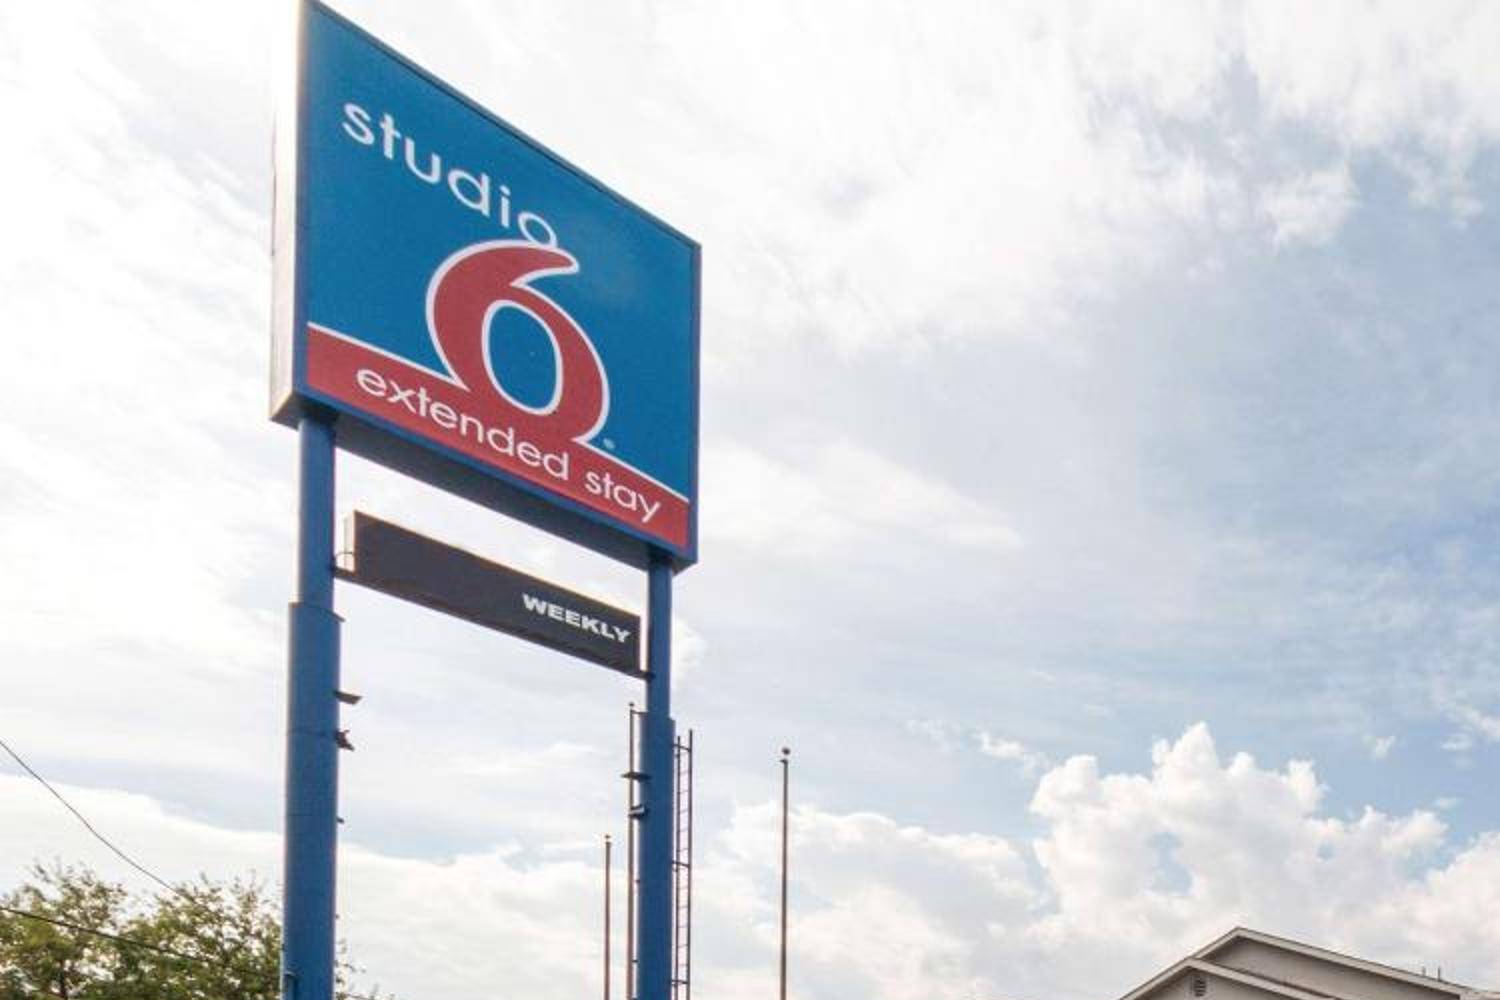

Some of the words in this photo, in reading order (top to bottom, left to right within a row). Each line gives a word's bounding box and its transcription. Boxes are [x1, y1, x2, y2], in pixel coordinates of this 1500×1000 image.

[341, 102, 557, 248] studio
[426, 238, 612, 449] 6
[356, 366, 570, 482] extended
[585, 470, 661, 524] stay
[521, 594, 632, 643] WEEKLY
